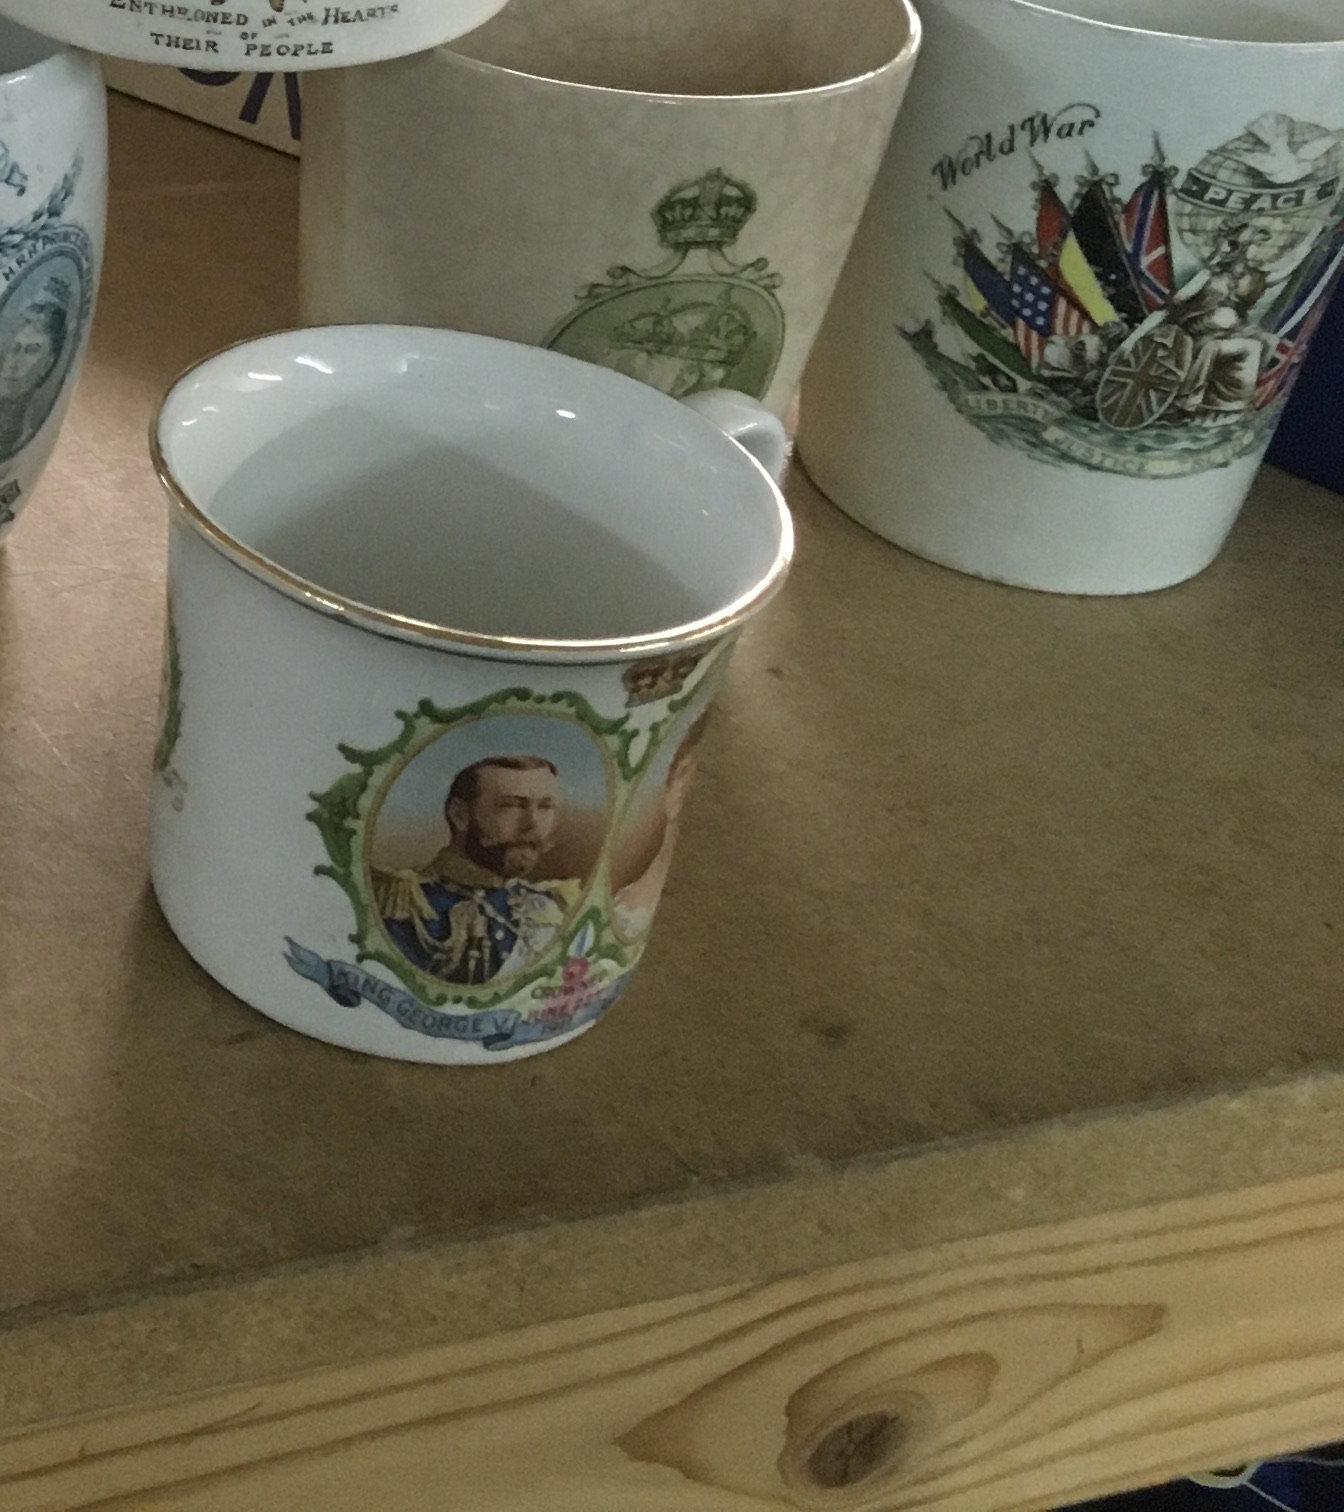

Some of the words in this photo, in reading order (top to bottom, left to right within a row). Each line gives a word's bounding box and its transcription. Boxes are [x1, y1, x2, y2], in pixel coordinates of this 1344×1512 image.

[931, 123, 1016, 191] World
[1019, 101, 1102, 149] War
[395, 1000, 482, 1033] GEORGE
